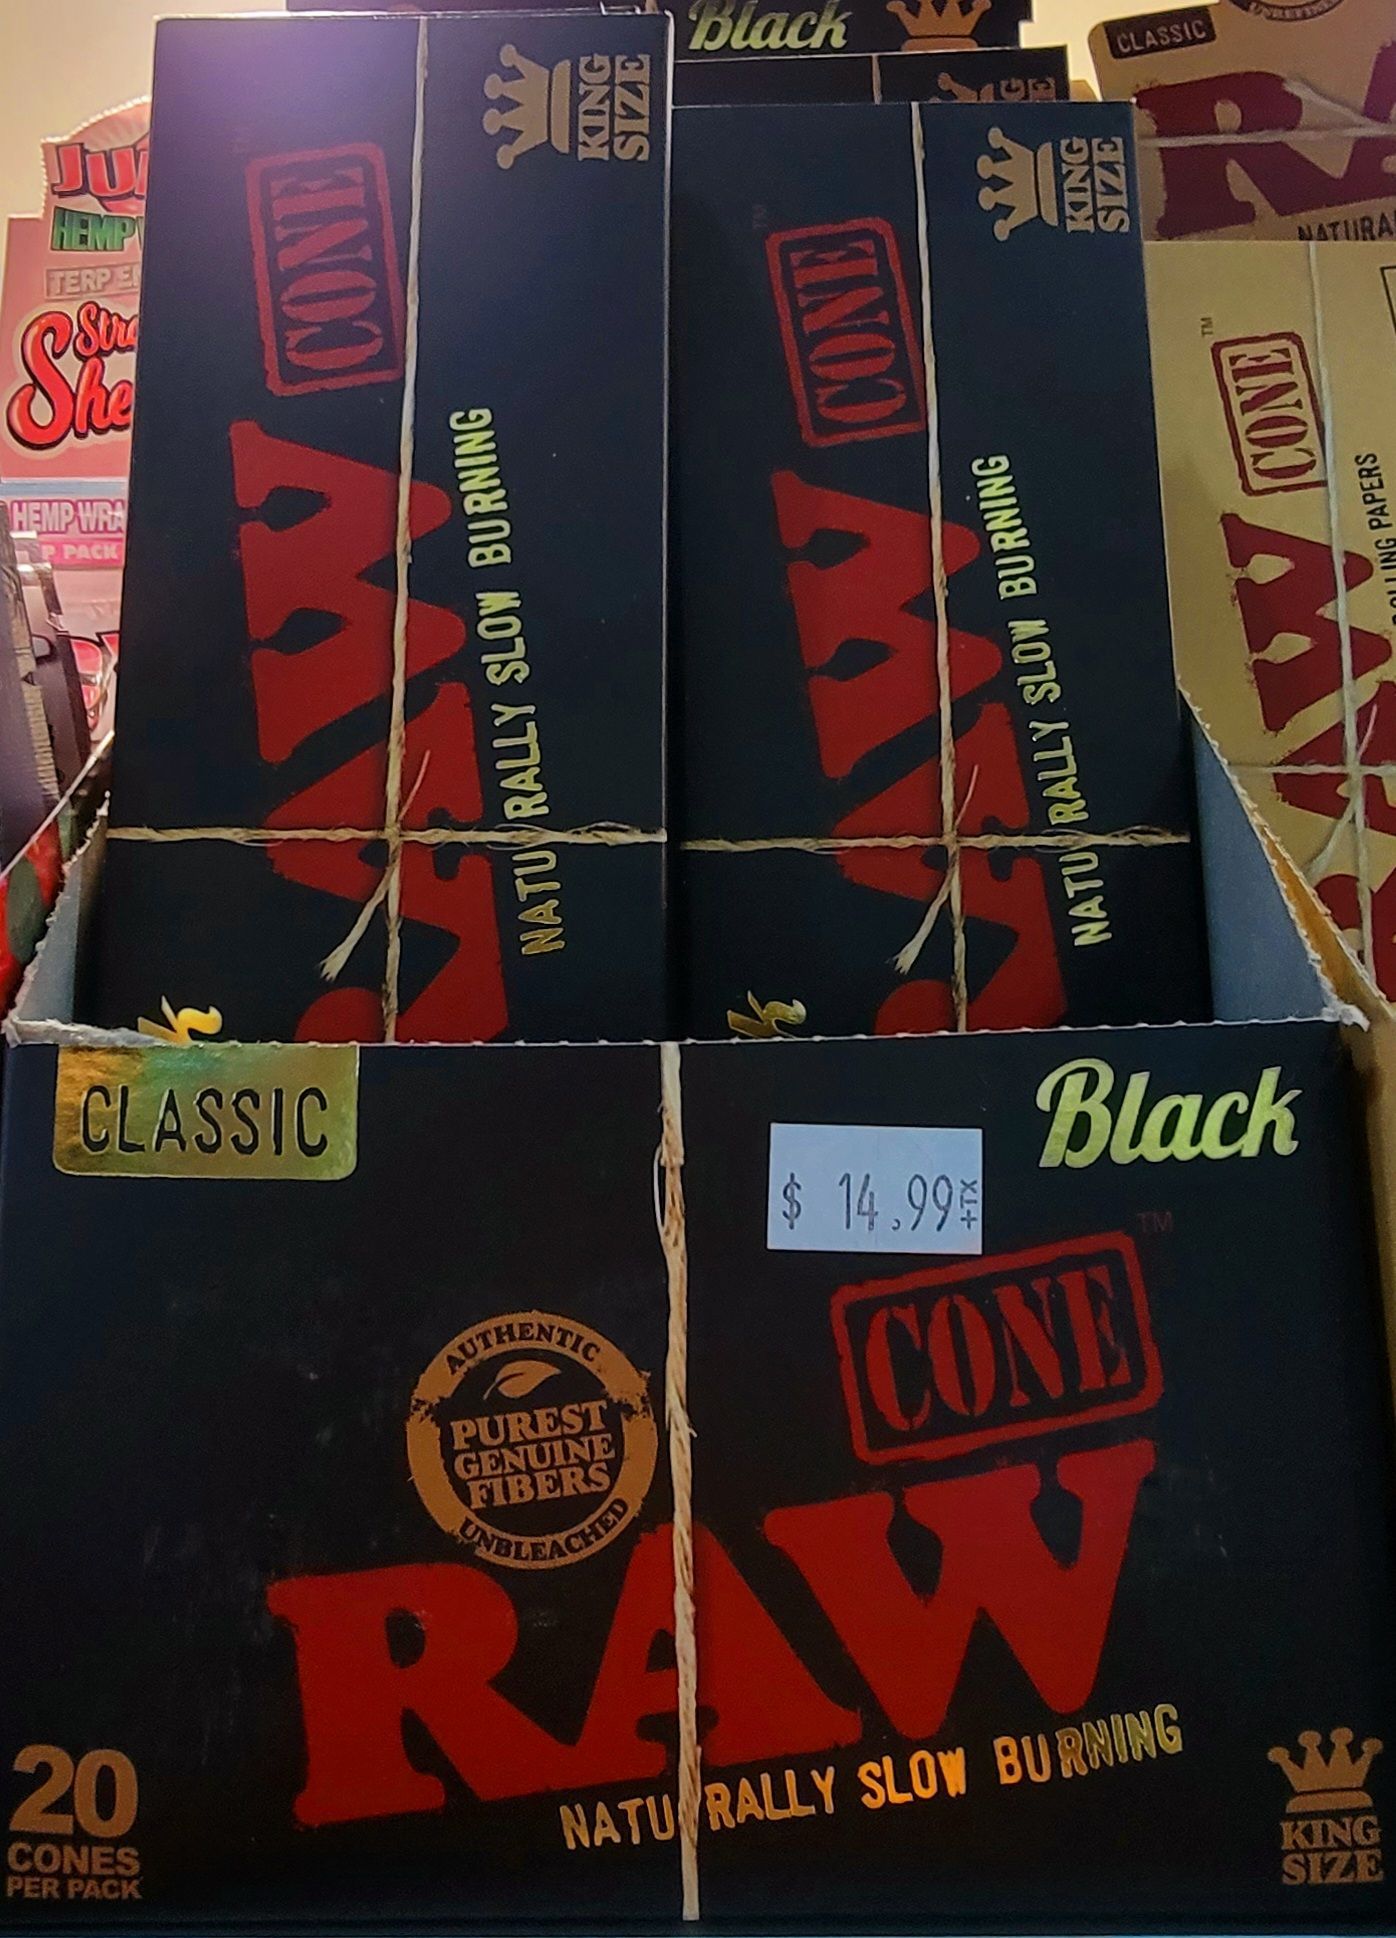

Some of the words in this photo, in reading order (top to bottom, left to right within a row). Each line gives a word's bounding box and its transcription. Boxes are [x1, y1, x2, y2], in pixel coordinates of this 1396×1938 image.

[688, 0, 853, 50] Black
[1116, 19, 1207, 53] CLASSIC
[578, 54, 611, 161] KING
[613, 54, 650, 161] SIZE
[1060, 136, 1095, 233] KING
[1092, 136, 1130, 233] SIZE
[52, 205, 136, 251] HEMP
[1297, 209, 1396, 241] NATURA
[50, 270, 111, 297] TERP
[270, 167, 384, 370] CONE
[790, 239, 907, 423] CONE
[1202, 317, 1214, 337] TM
[1229, 347, 1317, 480] CONE
[11, 499, 76, 534] HEMP
[449, 407, 512, 568] BURNING
[1355, 453, 1393, 530] PAPERS
[63, 543, 119, 561] PACK
[971, 453, 1037, 600] BURNING
[476, 591, 530, 686] SLOW
[1007, 619, 1062, 704] SLOW
[80, 1085, 329, 1158] CLASSIC
[1036, 1057, 1302, 1168] Black
[446, 1322, 600, 1376] AUTHENTIC
[865, 1264, 1133, 1431] CONE
[451, 1400, 607, 1450] PUREST
[454, 1433, 615, 1481] GENUINE
[467, 1462, 611, 1510] FIBERS
[458, 1498, 628, 1562] UNBLEACHED
[267, 1438, 1157, 1828] RAW
[9, 1743, 138, 1838] 20
[857, 1747, 967, 1810] SLOW
[993, 1703, 1184, 1785] BURNING
[7, 1842, 140, 1876] CONES
[1280, 1815, 1381, 1850] KING
[1282, 1848, 1384, 1886] SIZE
[7, 1876, 60, 1899] PER
[67, 1878, 143, 1900] PACK
